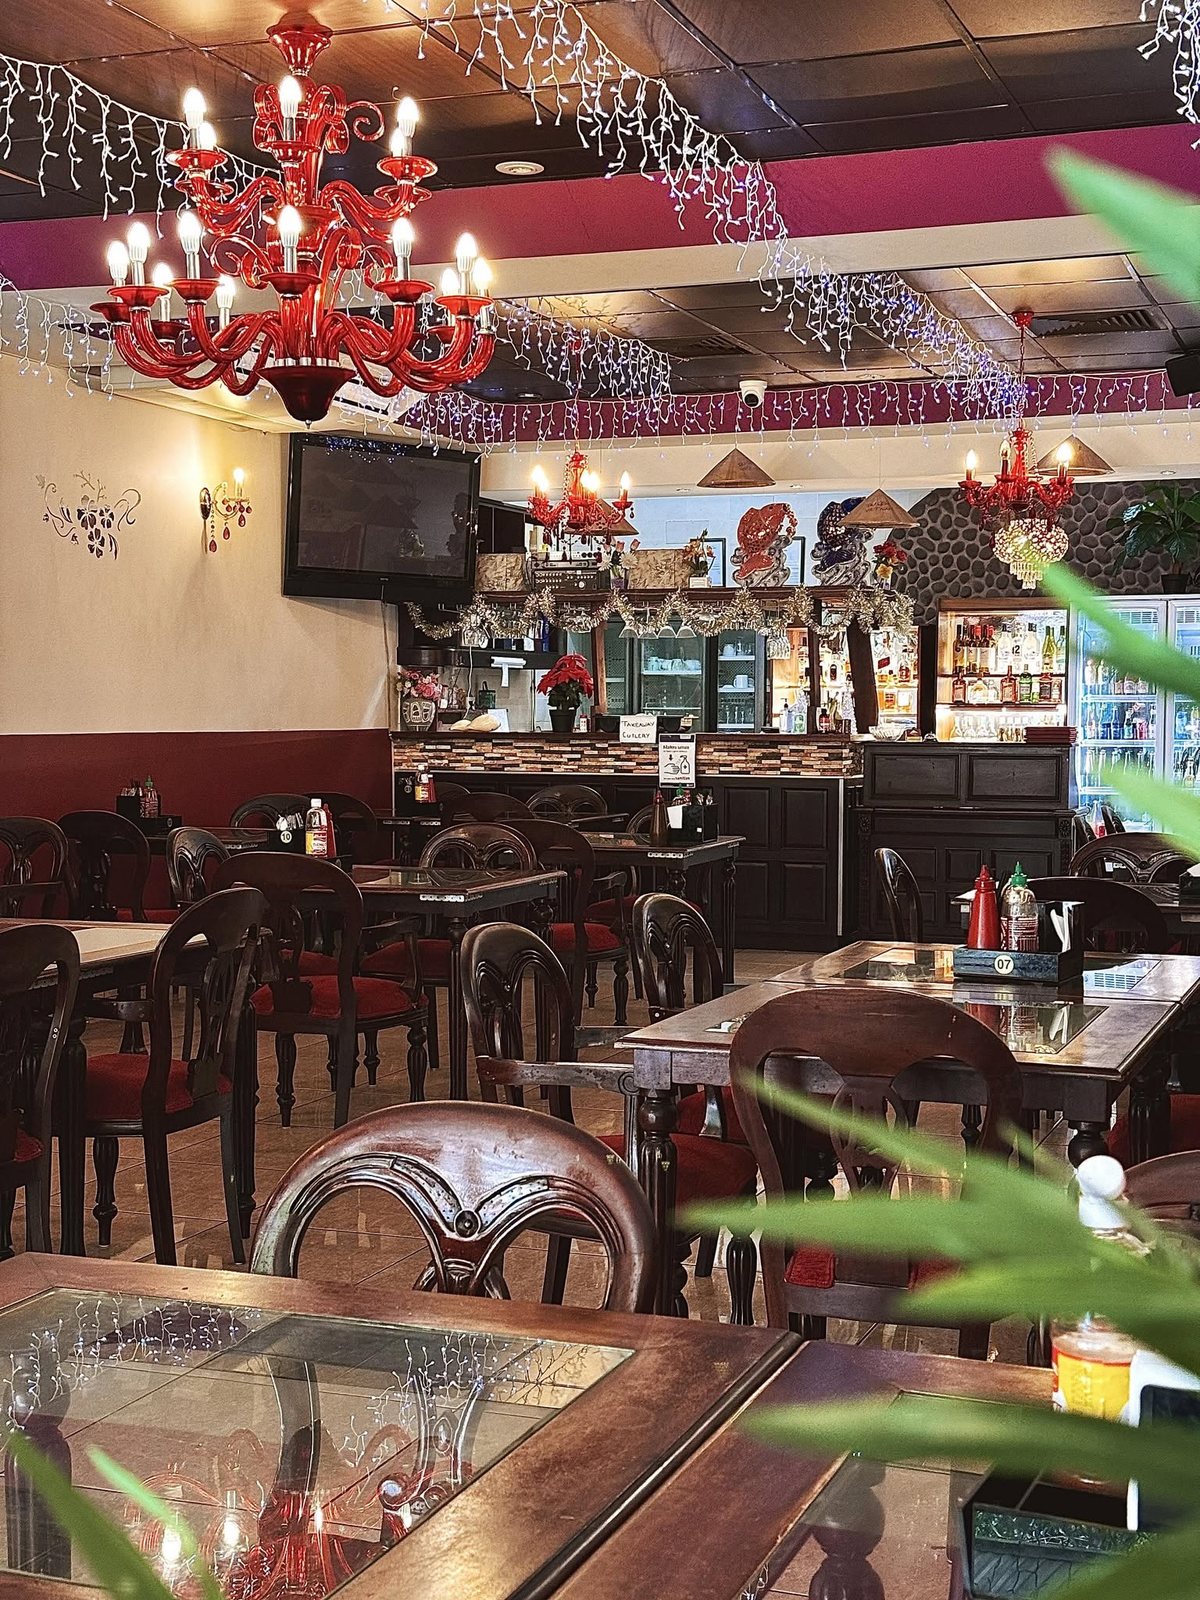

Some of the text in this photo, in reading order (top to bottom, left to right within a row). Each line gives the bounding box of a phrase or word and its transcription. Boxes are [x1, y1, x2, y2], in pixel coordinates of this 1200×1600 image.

[621, 720, 655, 728] TAKEAWAY
[622, 731, 650, 739] CUTLERY
[282, 833, 291, 841] 10
[997, 959, 1011, 970] 07
